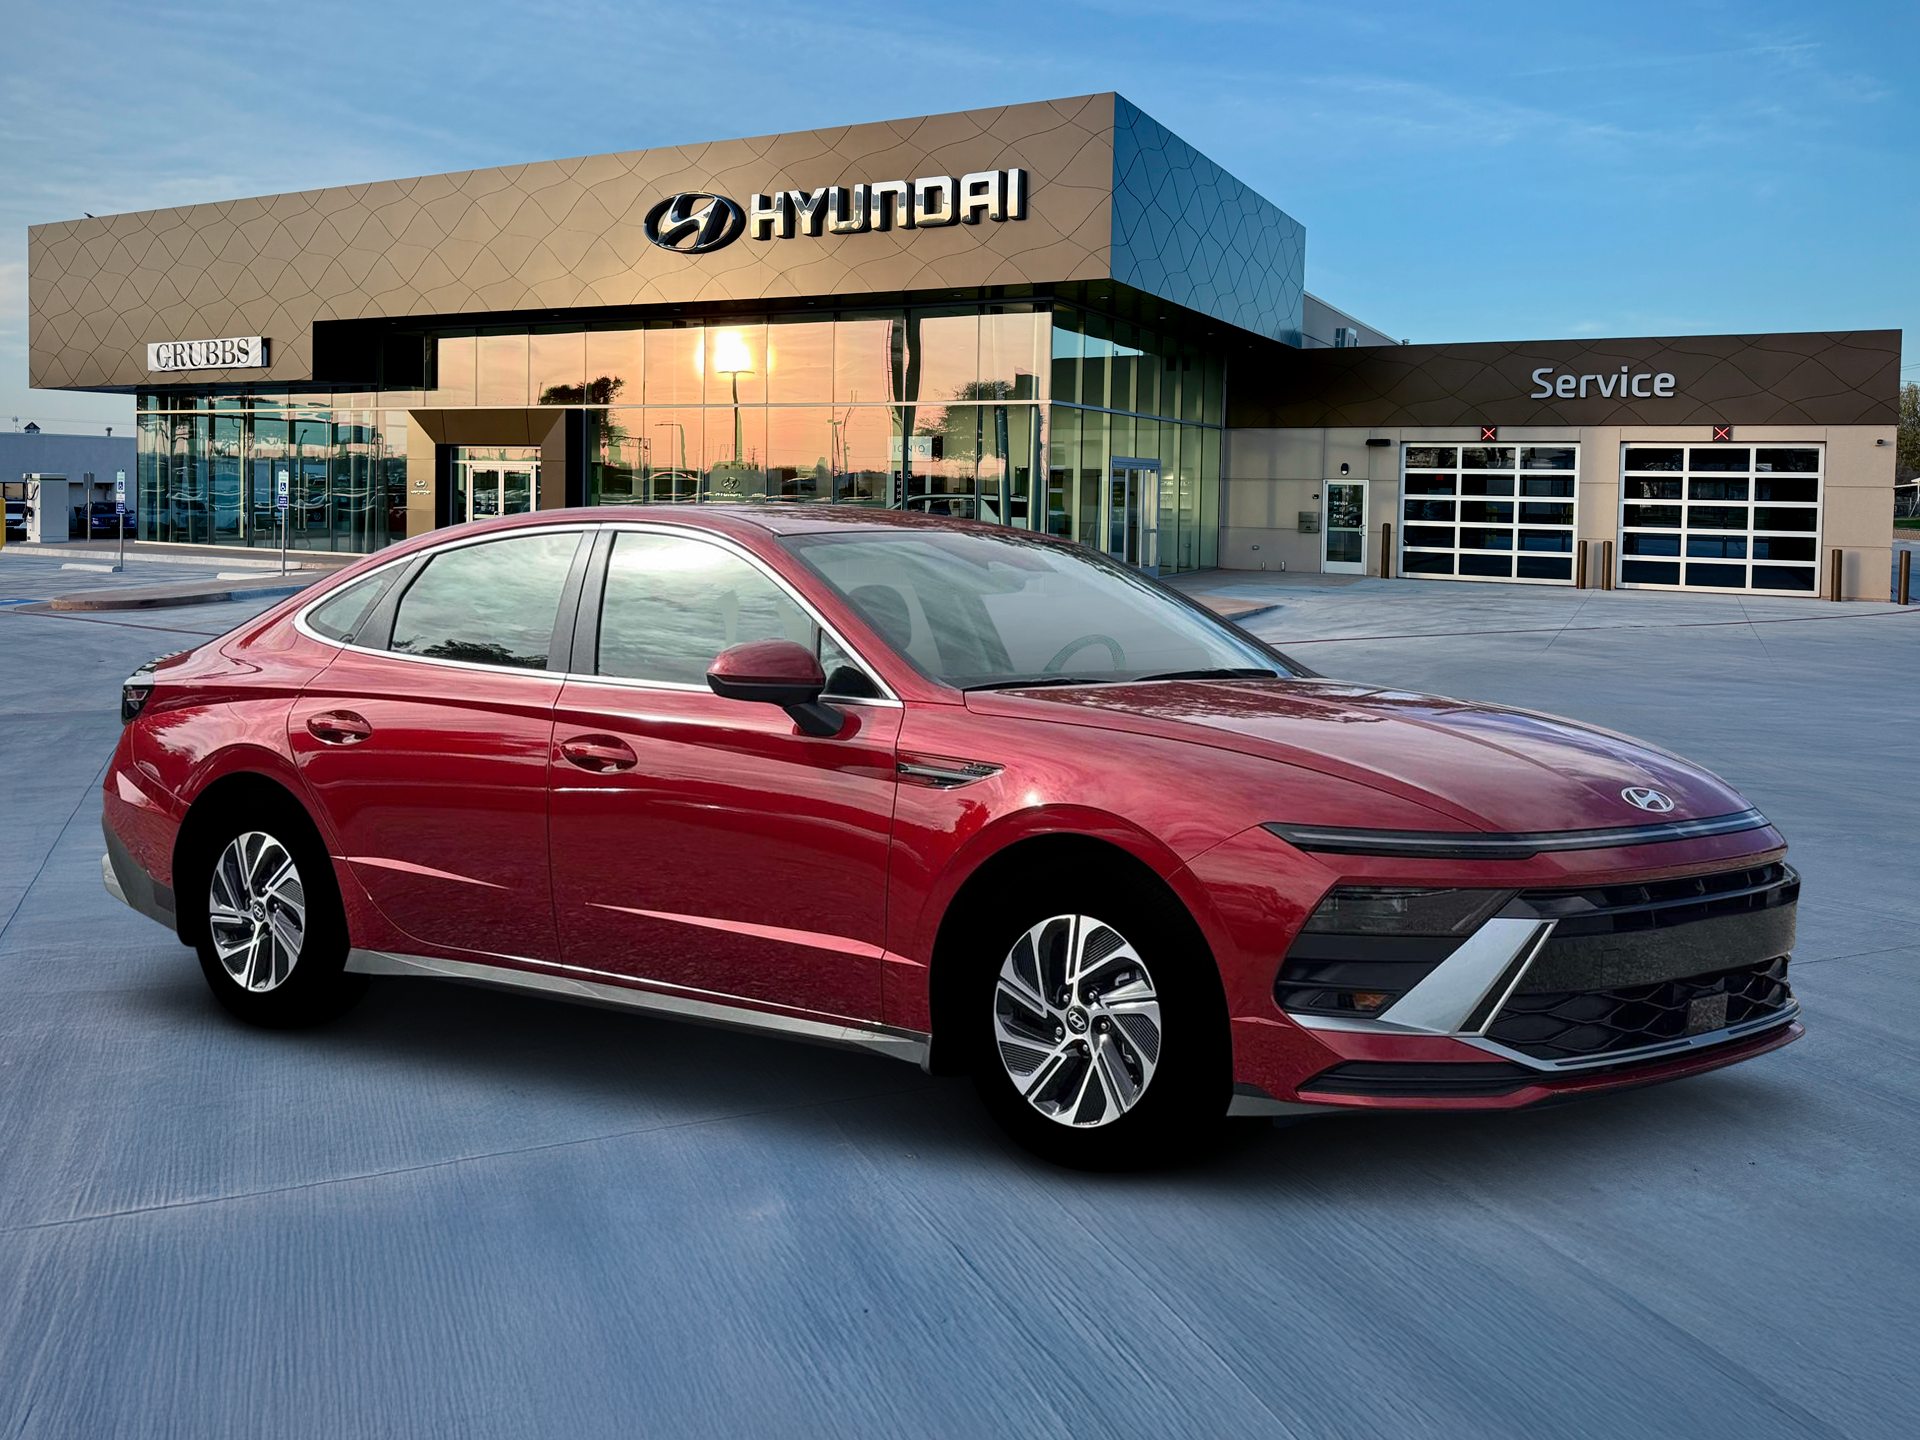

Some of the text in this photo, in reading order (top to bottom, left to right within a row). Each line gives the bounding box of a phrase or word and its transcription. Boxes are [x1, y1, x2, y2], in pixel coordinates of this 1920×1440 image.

[750, 168, 1026, 240] HYUNDAI
[156, 338, 250, 369] GRUBBS
[1530, 365, 1676, 399] Service
